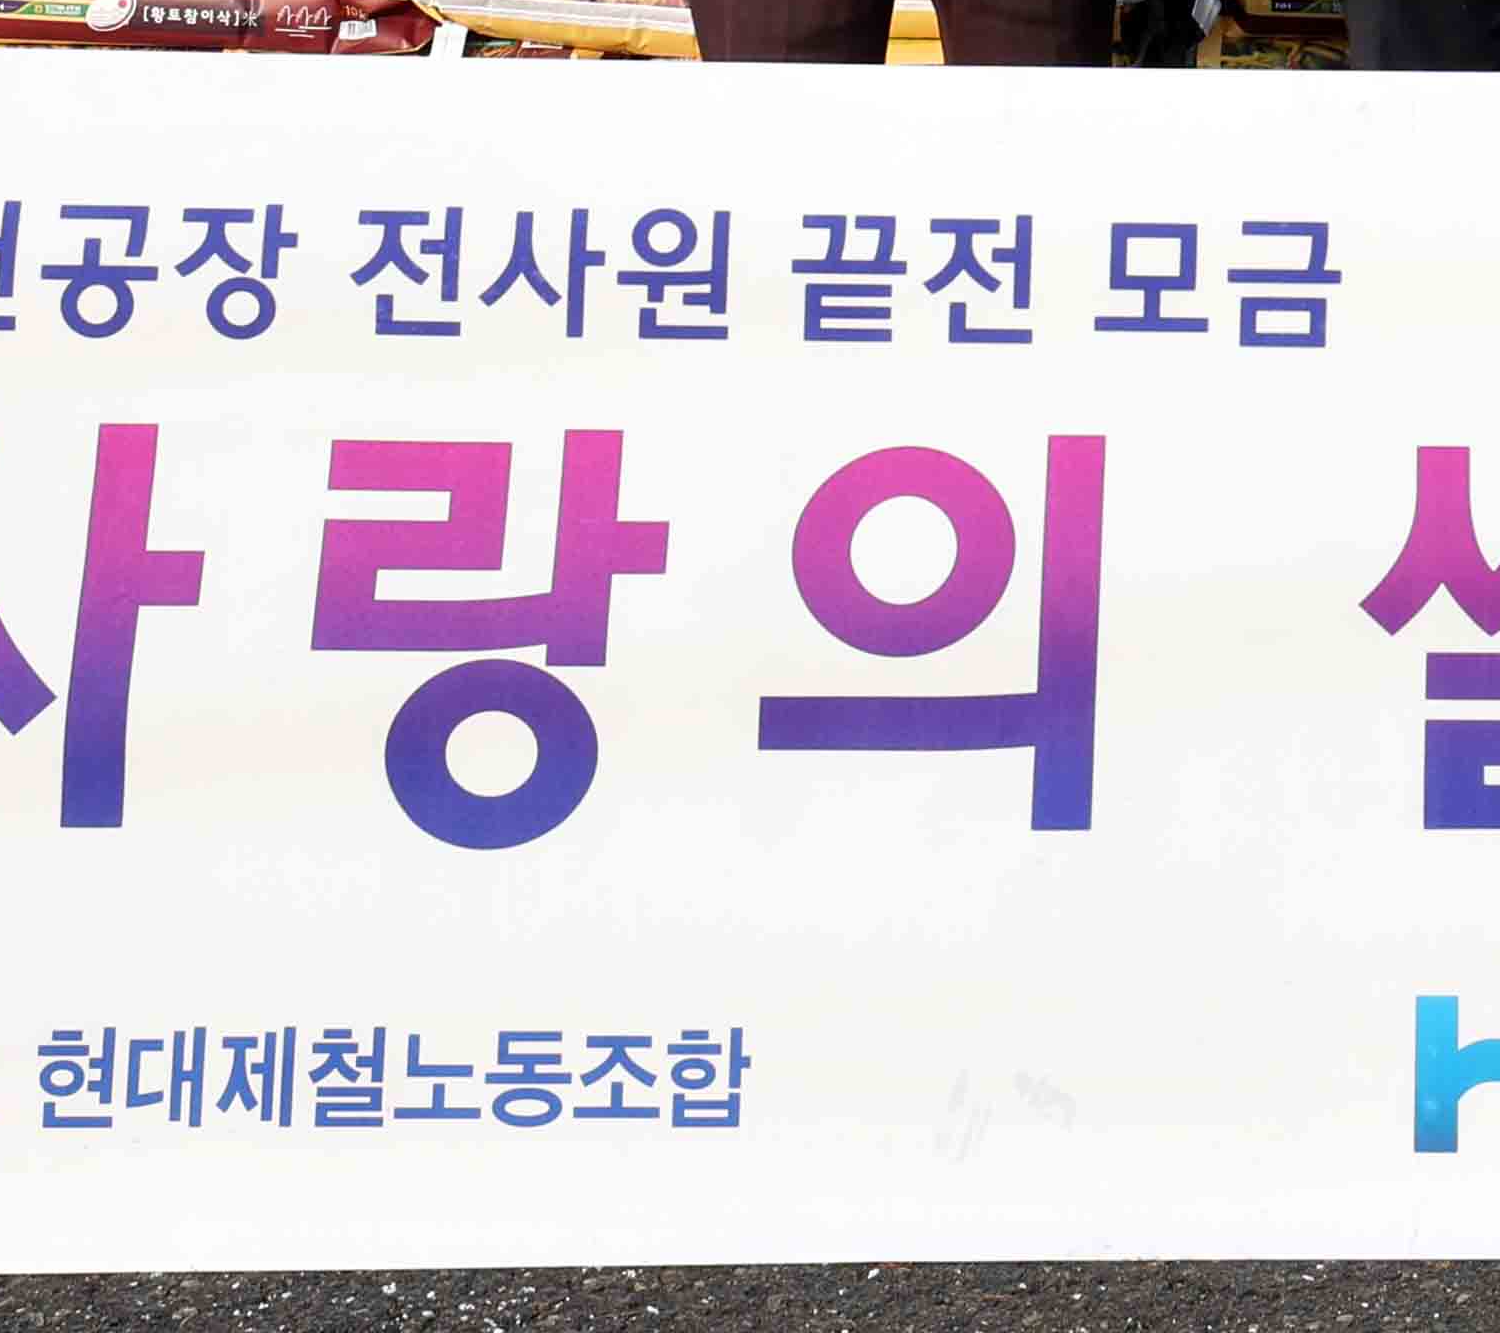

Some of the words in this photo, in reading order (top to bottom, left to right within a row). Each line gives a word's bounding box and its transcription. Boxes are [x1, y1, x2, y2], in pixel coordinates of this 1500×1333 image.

[350, 207, 730, 340] 전사원
[792, 215, 1032, 344] 끝전
[1094, 221, 1342, 348] 모금
[38, 1027, 751, 1128] 현대제철노동조합
